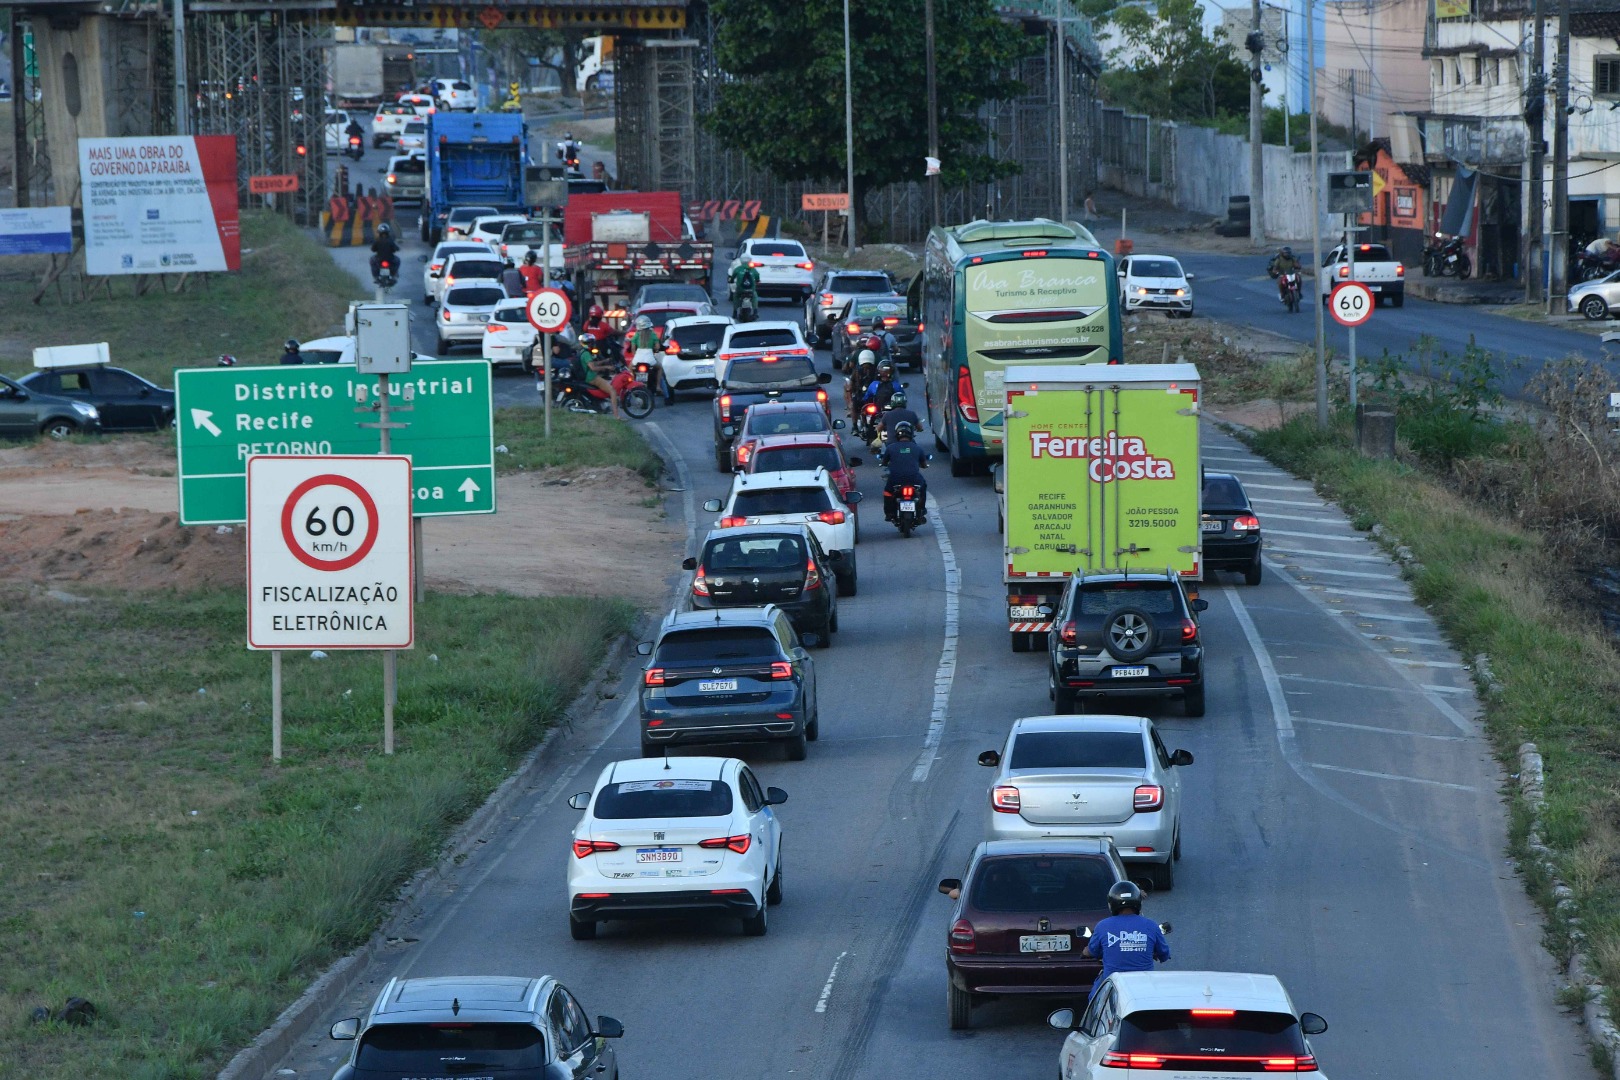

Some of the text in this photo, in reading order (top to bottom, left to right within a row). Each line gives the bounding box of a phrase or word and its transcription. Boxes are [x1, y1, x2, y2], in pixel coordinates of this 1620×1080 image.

[89, 145, 183, 160] MAIS UMA OBRA DO
[90, 162, 136, 175] GOVERNO
[137, 162, 150, 174] DA
[817, 198, 845, 206] DESVIO
[1017, 269, 1097, 288] Branca
[1037, 287, 1077, 296] Receptivo
[537, 302, 560, 316] 60
[1340, 295, 1363, 310] 60
[983, 335, 1090, 348] asabrancaturismo.com.br
[234, 382, 333, 401] Distrito
[236, 412, 313, 431] Recife
[1030, 431, 1146, 457] Ferreira
[1088, 456, 1174, 482] Costa
[1125, 507, 1147, 515] JOÃO
[305, 505, 355, 537] 60
[1128, 519, 1177, 528] 3219.5000
[312, 541, 348, 552] km/h
[262, 582, 398, 606] FISCALIZAÇÃO
[272, 610, 388, 631] ELETRÔNICA
[640, 852, 678, 862] SNM3B90
[1021, 941, 1069, 951] KLE 1716
